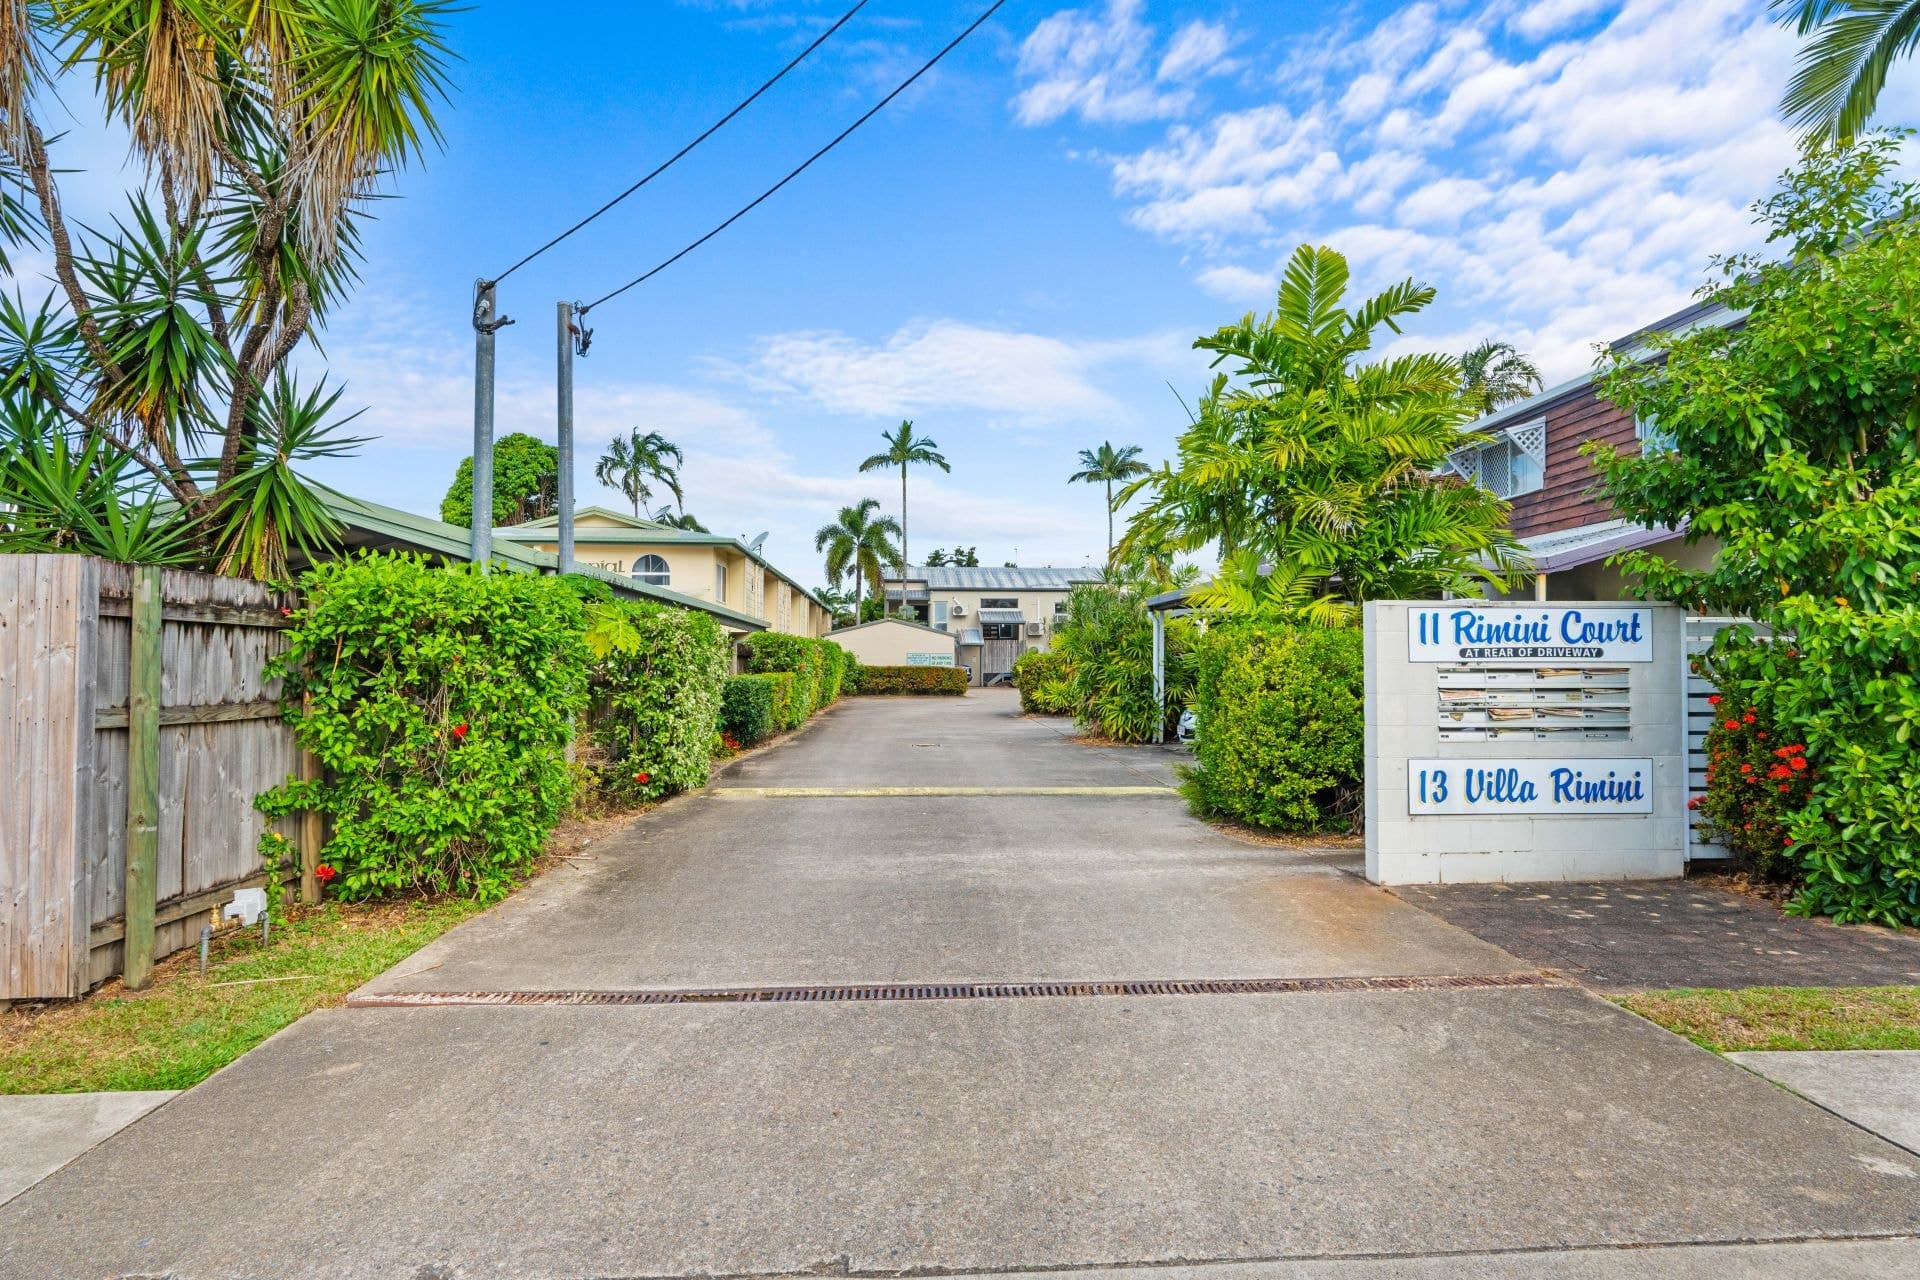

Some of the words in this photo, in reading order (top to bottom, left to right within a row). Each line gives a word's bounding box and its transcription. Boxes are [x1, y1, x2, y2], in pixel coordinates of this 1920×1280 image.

[1419, 612, 1440, 645] 11
[1450, 610, 1552, 645] Rimini
[1560, 610, 1643, 645] Court
[1465, 648, 1479, 657] AT
[1484, 648, 1514, 657] REAR
[1518, 648, 1533, 657] OF
[1538, 647, 1598, 657] DRIVEWAY
[1419, 770, 1448, 804] 13
[1465, 767, 1538, 803] Villa
[1550, 767, 1644, 804] Rimini
